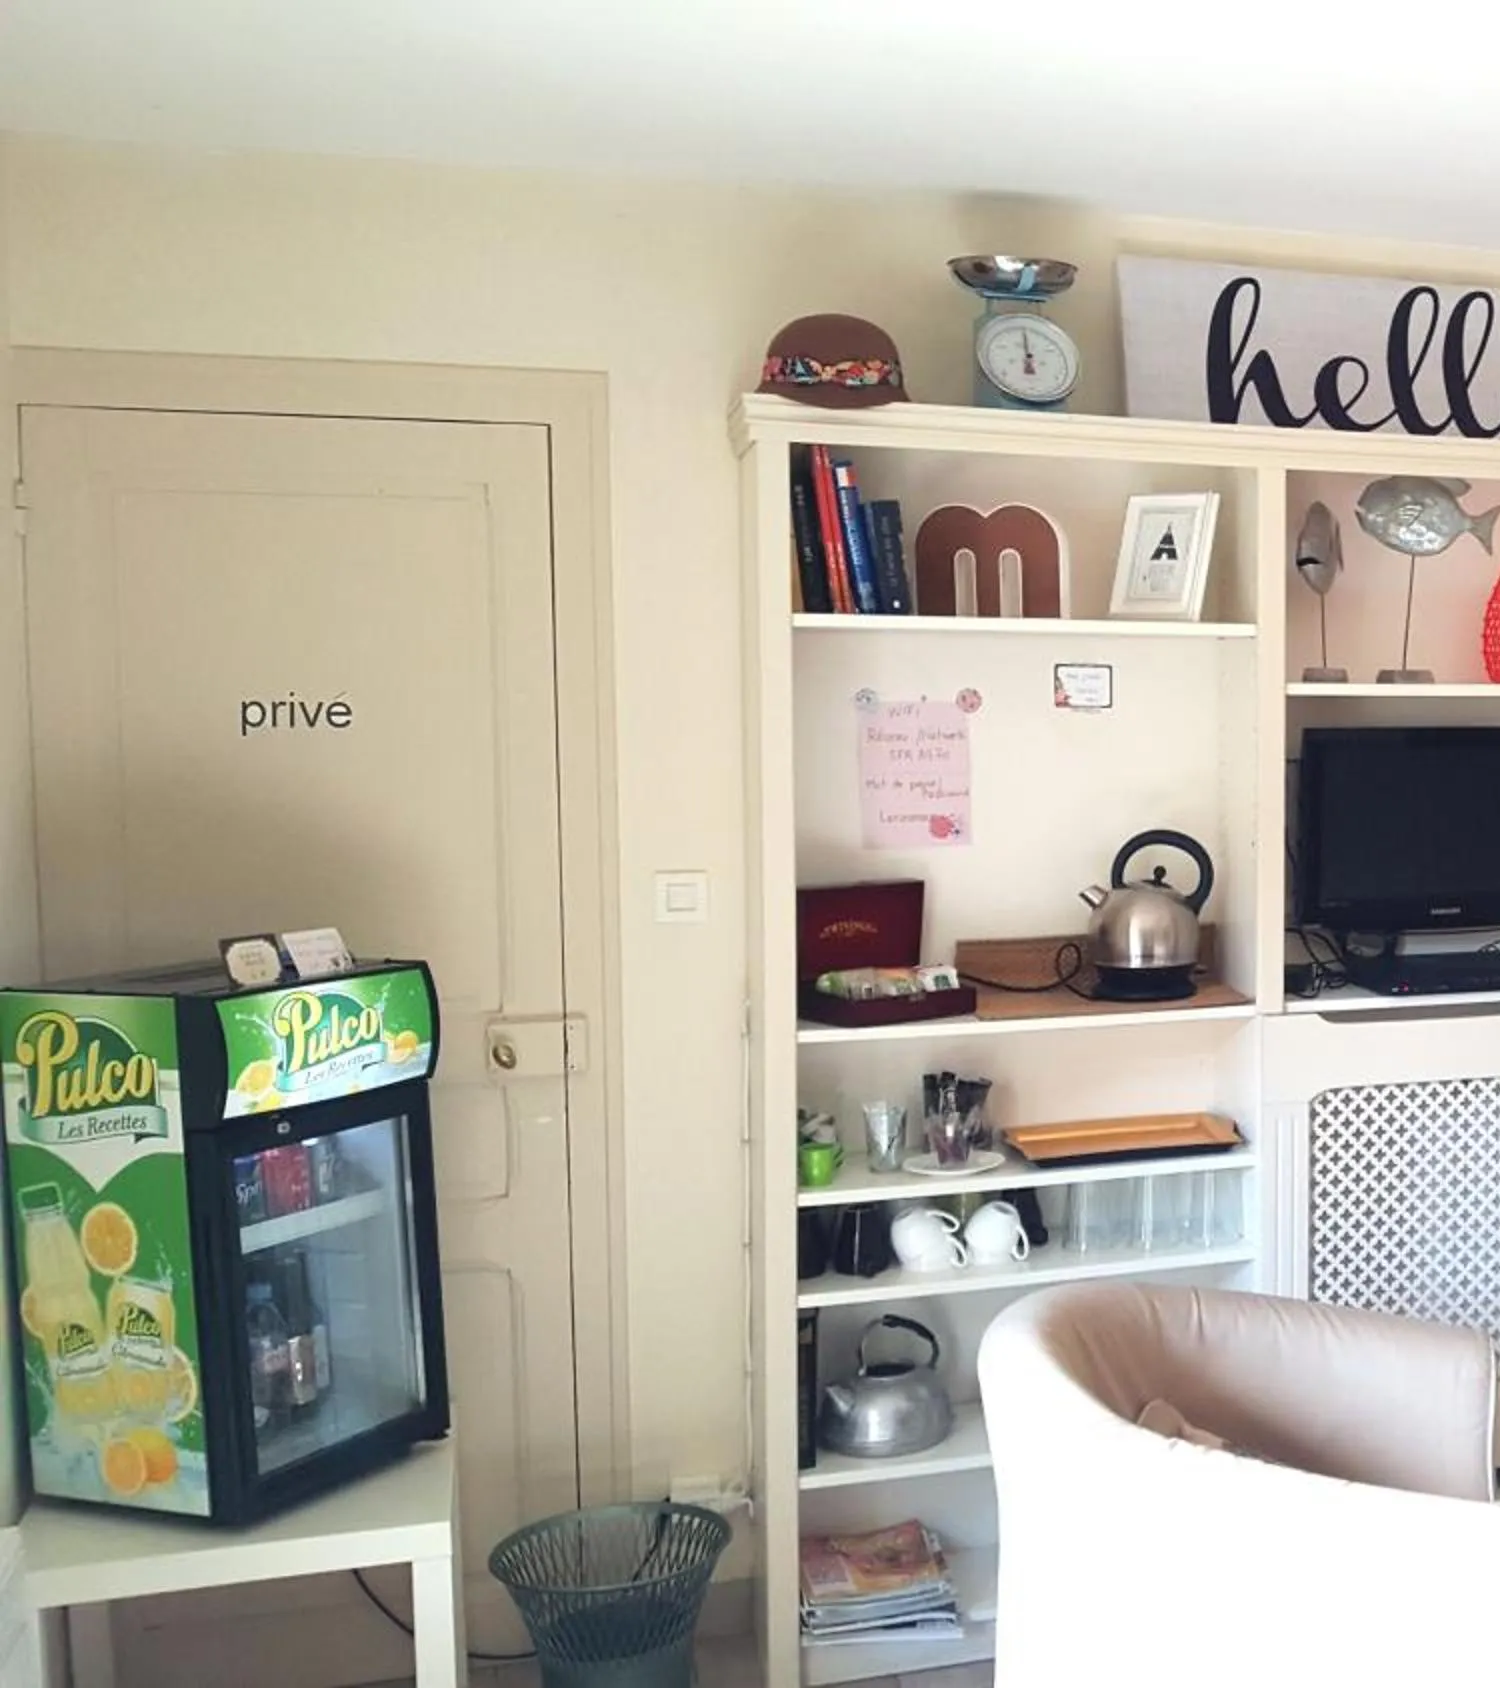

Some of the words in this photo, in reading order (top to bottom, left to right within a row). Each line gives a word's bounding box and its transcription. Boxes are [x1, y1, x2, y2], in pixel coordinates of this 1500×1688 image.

[241, 691, 353, 736] privé
[272, 991, 380, 1073] Pulco
[16, 1011, 154, 1118] Pulco
[58, 1121, 83, 1139] Les
[87, 1114, 148, 1137] Recettes
